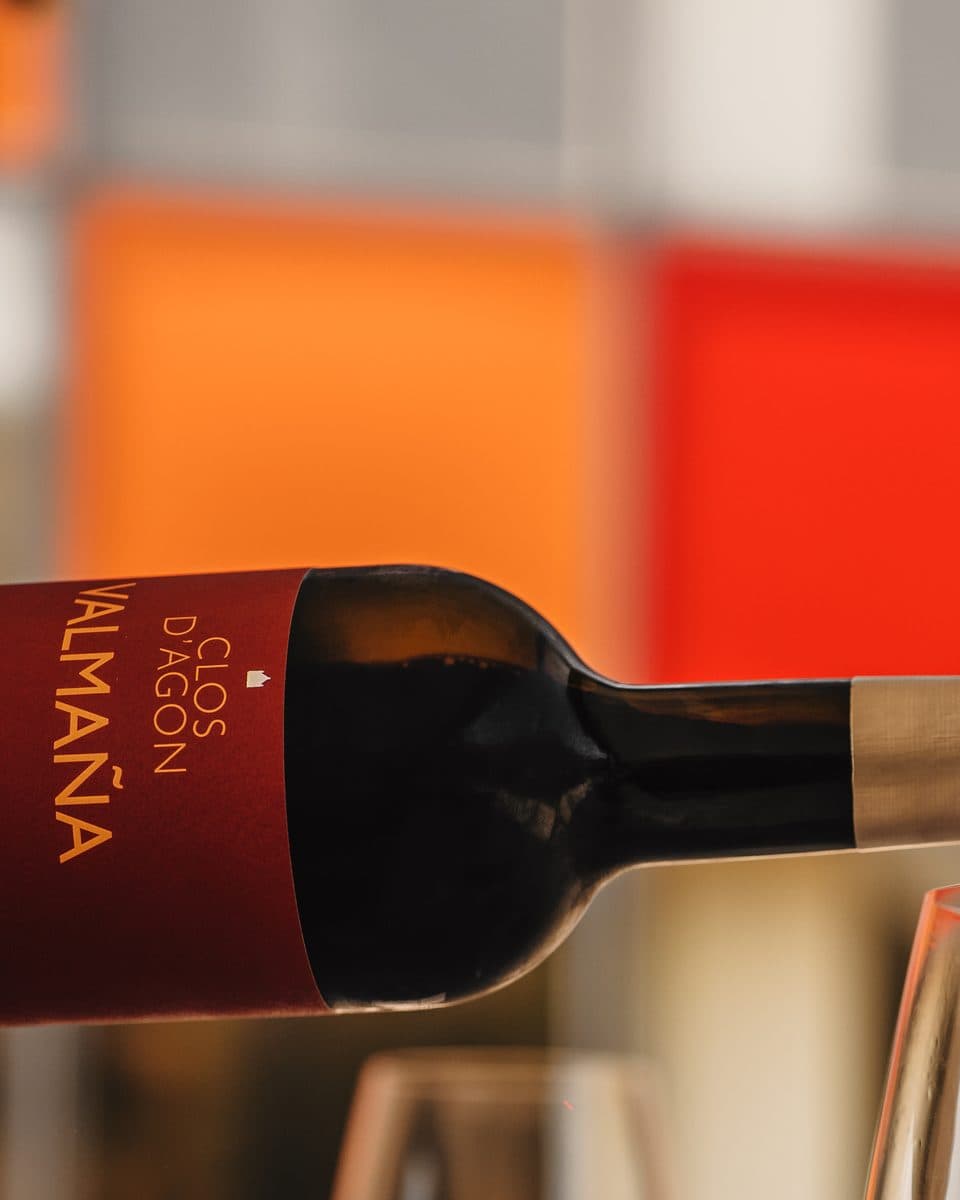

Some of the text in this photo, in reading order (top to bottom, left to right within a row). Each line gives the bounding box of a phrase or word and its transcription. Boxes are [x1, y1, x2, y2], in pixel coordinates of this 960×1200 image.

[53, 582, 137, 864] VALMAÑA
[153, 616, 197, 773] D'AGON
[193, 636, 231, 737] CLOS
